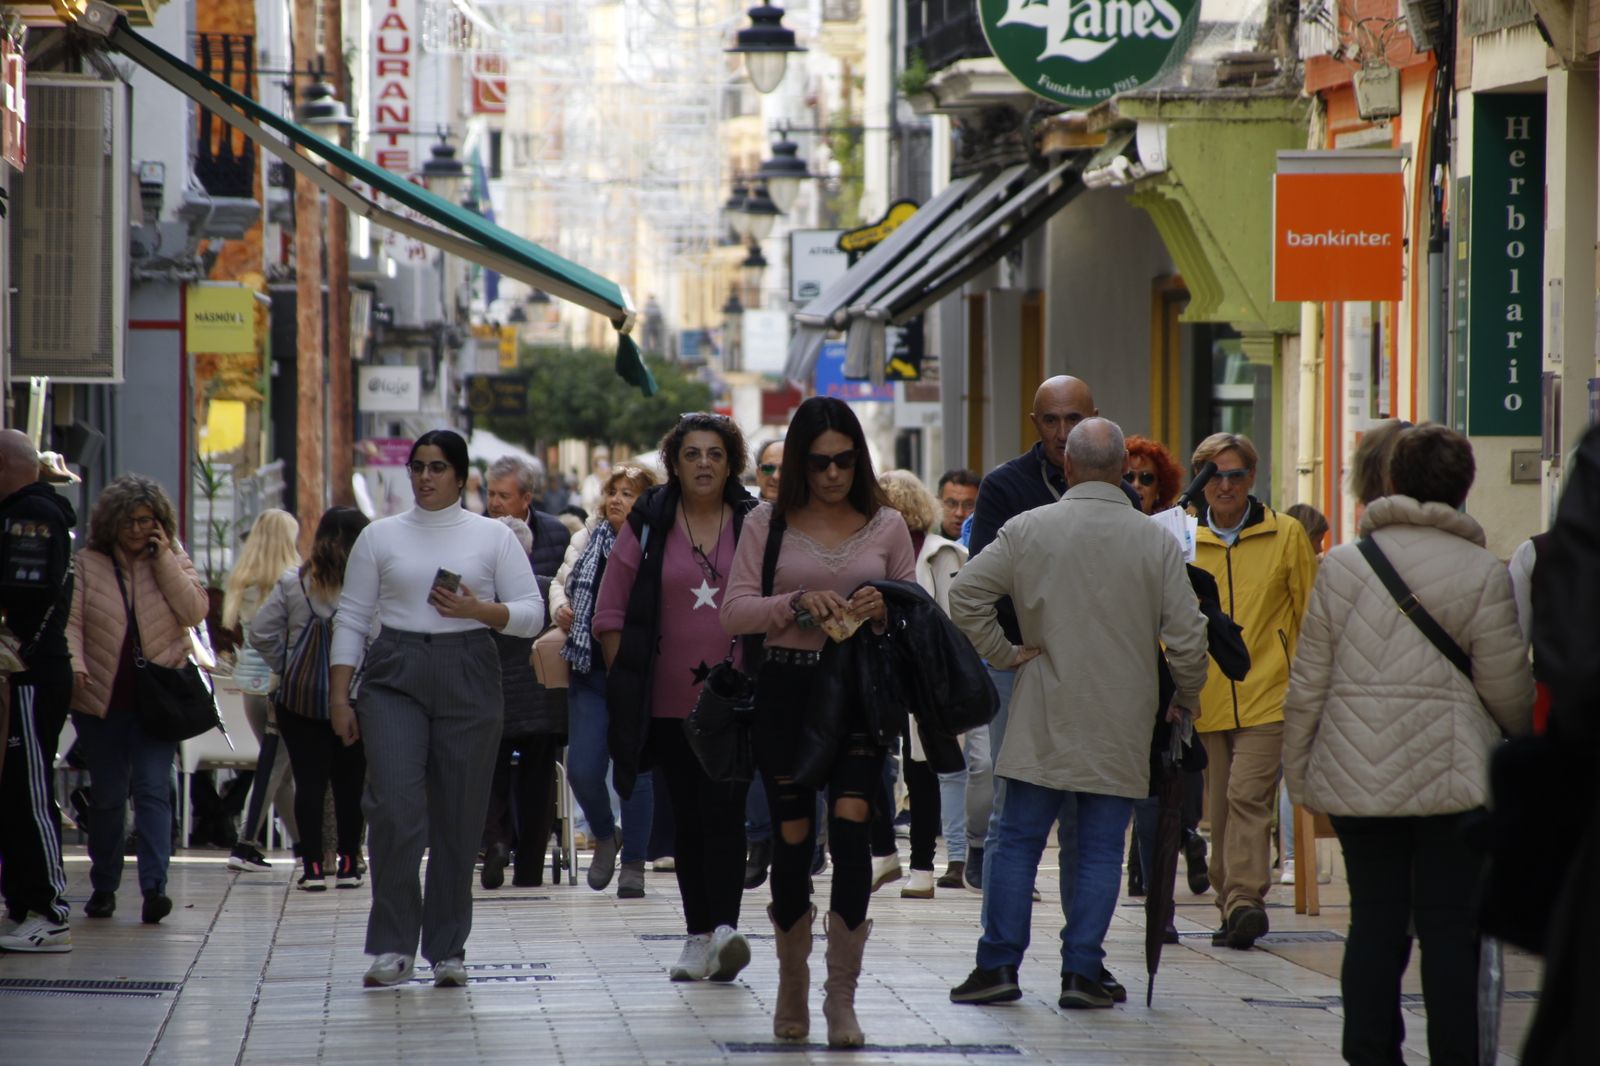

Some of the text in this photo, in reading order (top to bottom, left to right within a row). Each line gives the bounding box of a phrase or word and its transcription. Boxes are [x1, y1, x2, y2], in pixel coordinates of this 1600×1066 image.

[1037, 73, 1139, 98] Fundada en 1915
[1504, 116, 1531, 411] Herbolario
